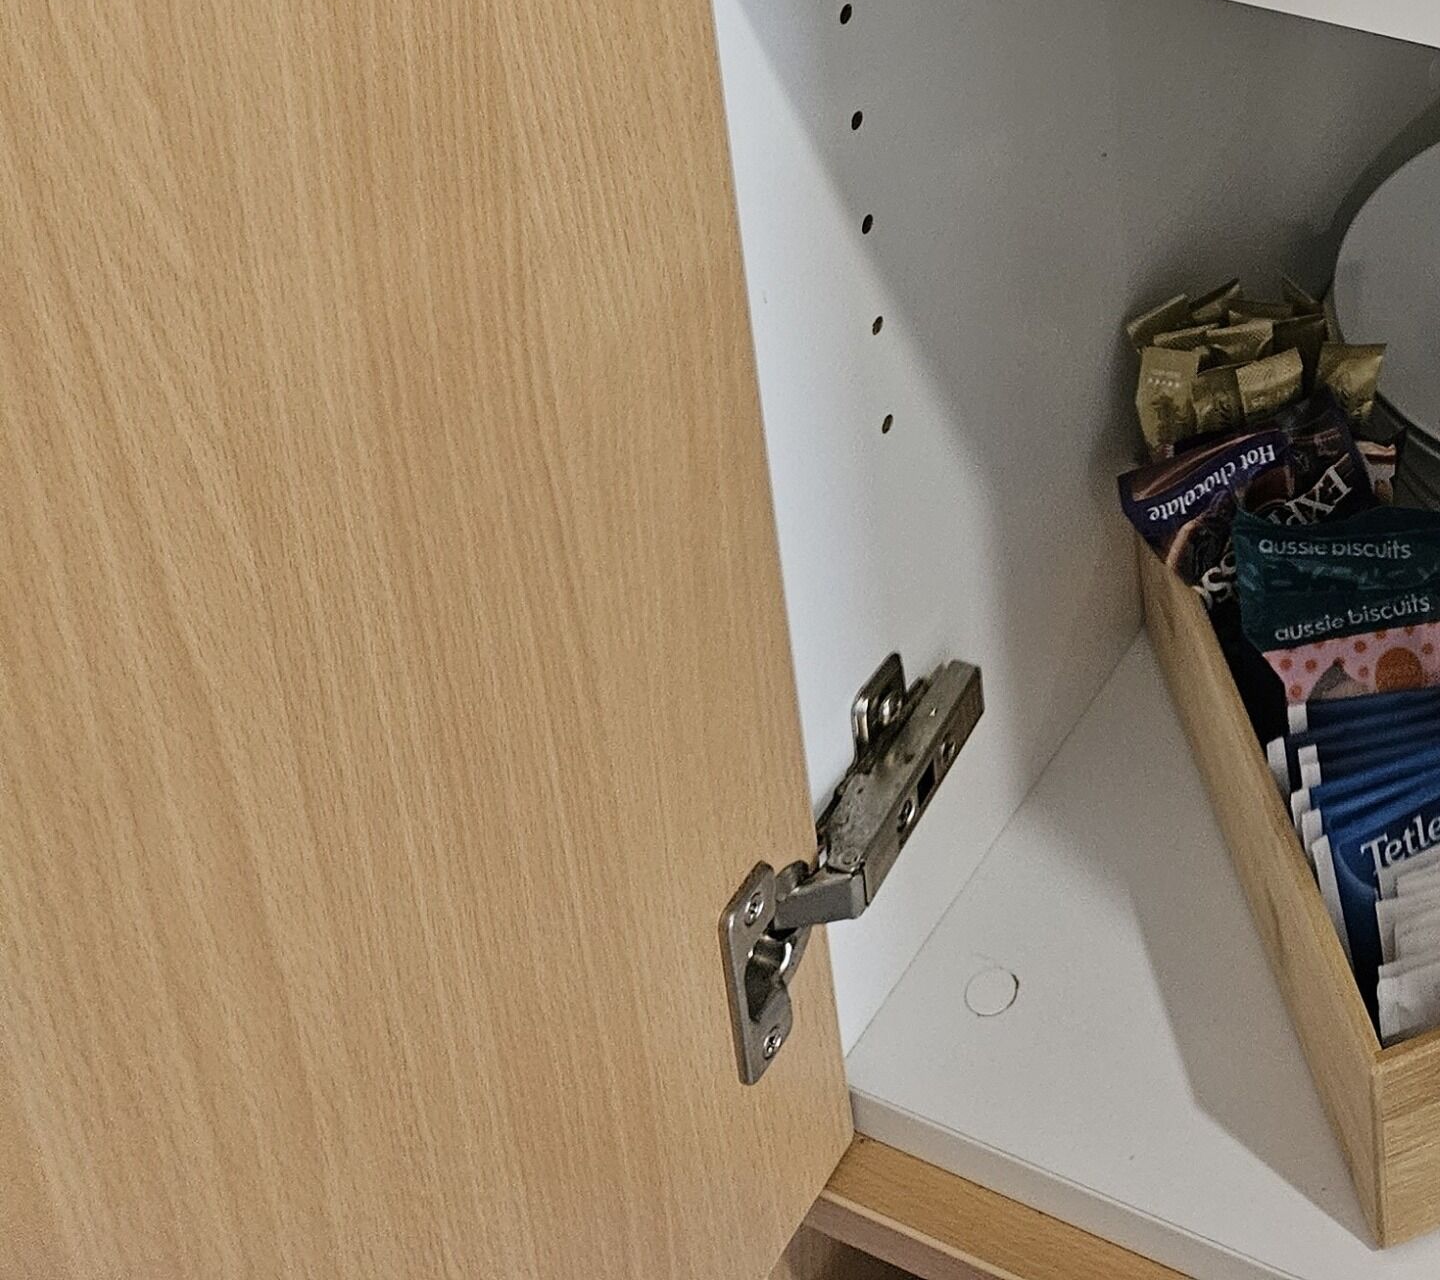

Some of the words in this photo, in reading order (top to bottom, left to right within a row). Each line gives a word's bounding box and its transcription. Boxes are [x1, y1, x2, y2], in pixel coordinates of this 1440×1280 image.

[1239, 444, 1276, 475] Hot
[1148, 462, 1237, 523] chocolate
[1258, 538, 1328, 556] aussie
[1330, 540, 1412, 560] biscuits
[1274, 615, 1345, 641] aussie
[1347, 593, 1431, 626] biscuits
